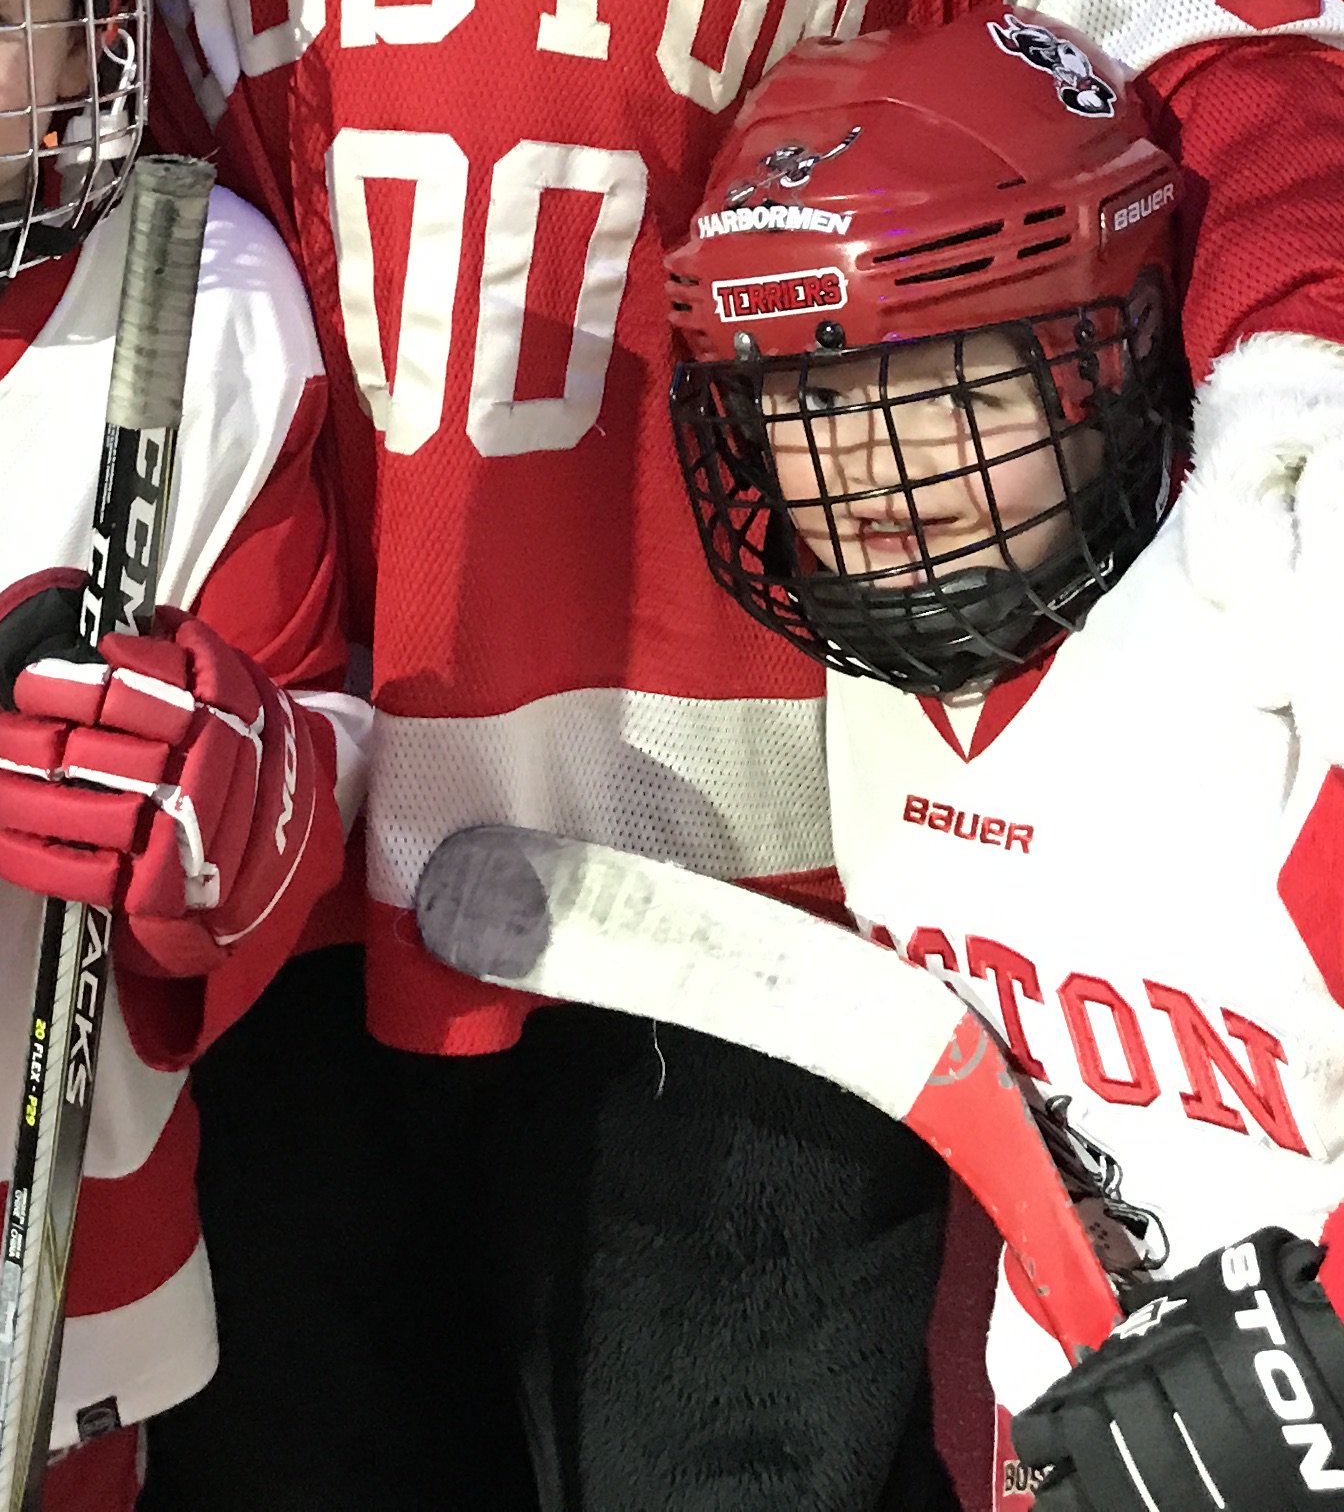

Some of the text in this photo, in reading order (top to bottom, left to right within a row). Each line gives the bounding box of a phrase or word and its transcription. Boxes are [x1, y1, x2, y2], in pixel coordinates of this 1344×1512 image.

[697, 205, 853, 240] HARBORMEN
[1114, 183, 1176, 232] BAUER
[324, 127, 650, 458] 00
[717, 272, 843, 319] TERRIERS
[113, 426, 166, 637] CCM
[902, 794, 1035, 854] BAUER
[34, 1018, 47, 1040] 20
[30, 1042, 44, 1083] FLEX
